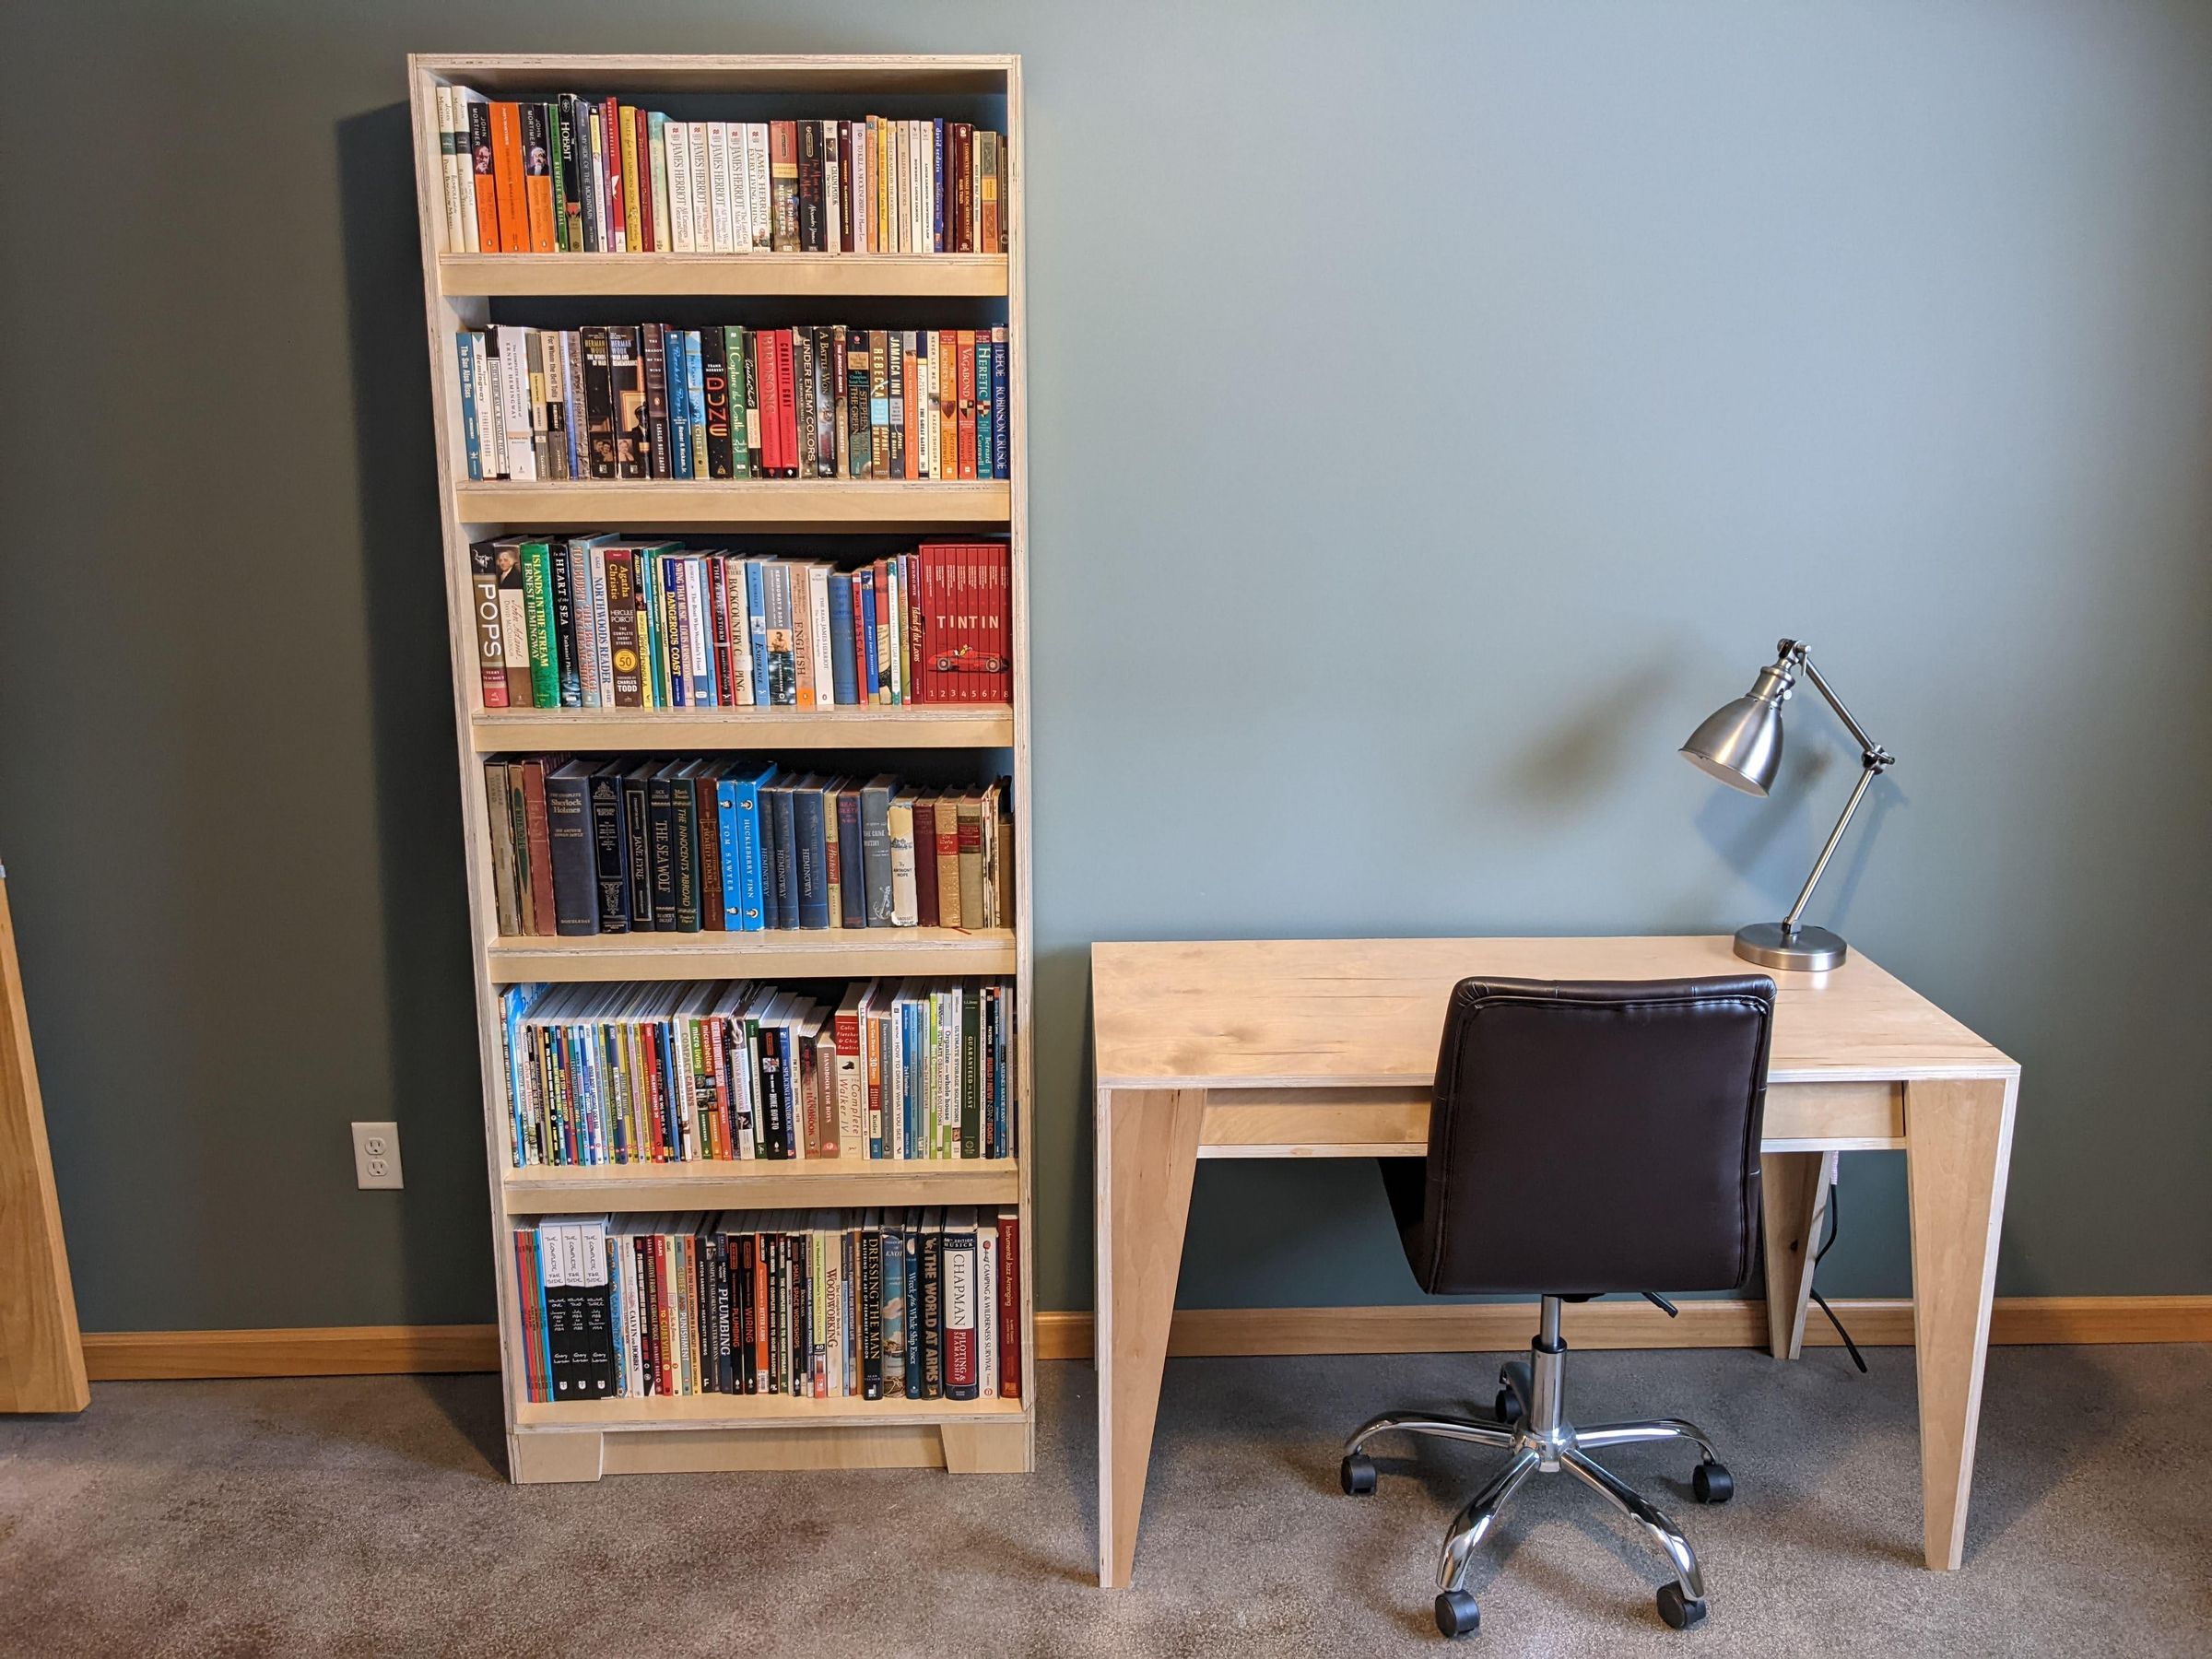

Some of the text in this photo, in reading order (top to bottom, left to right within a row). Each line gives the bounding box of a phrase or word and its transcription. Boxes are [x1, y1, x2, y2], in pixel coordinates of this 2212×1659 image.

[527, 111, 535, 146] MORTIMER
[561, 122, 571, 161] HOBBIT
[582, 135, 587, 144] MY
[671, 143, 687, 206] JAMES HERRIOT
[692, 142, 707, 206] JAMES HERRIOT
[711, 144, 725, 206] JAMES HERRIOT
[730, 146, 745, 209] JAMES HERRIOT
[755, 147, 768, 227] JAMES HERRIOT
[460, 346, 468, 356] The
[728, 352, 741, 388] Capture
[762, 335, 775, 414] BIRDSONG
[780, 343, 791, 407] CHARLOTTE GRAY
[873, 348, 884, 398] REBECCA
[890, 337, 900, 395] JAMAICA INN
[961, 348, 971, 397] VAGABOND
[978, 347, 991, 396] HERETIC
[732, 391, 740, 401] the
[733, 404, 743, 432] Castle
[803, 339, 816, 461] UNDER ENEMY COLORS
[995, 349, 1006, 469] DEFOE ROBINSON CRUSOE
[556, 559, 568, 625] HEART SEA
[608, 563, 618, 599] Christie
[619, 566, 629, 597] Agatha
[477, 583, 501, 657] POPS
[524, 563, 539, 659] ERNEST HEMINGWAY
[532, 555, 548, 666] ISLANDS IN THE STREAM
[594, 577, 610, 684] NORTHWOODS READER
[666, 591, 678, 644] DANGEROUS
[672, 647, 681, 677] COAST
[728, 579, 745, 691] BACKCOUNTRY CPING
[936, 616, 999, 629] TINTIN
[619, 656, 632, 667] 50
[755, 642, 764, 684] ENDURANCE
[794, 621, 806, 676] ENGLISH
[633, 835, 644, 879] JANE EYRE
[655, 820, 670, 893] THE SEA WOLF
[677, 809, 689, 906] THE INNOCENTS ABROAD
[725, 853, 734, 891] SAWYER
[744, 819, 752, 874] HUCKLEBERRY
[761, 848, 770, 897] HEMINGWAY
[802, 848, 811, 897] HEMINGWAY
[777, 850, 786, 899] HEMINGWAY
[681, 1032, 694, 1106] COMPACT CABINS
[694, 1049, 702, 1068] living
[702, 1025, 712, 1072] microshelters
[782, 1066, 793, 1131] SPLICING HANDBOOK
[840, 1078, 849, 1132] Walker IV
[852, 1084, 860, 1134] Complete
[677, 1267, 686, 1294] CUBES
[826, 1268, 838, 1348] WOODWORKING
[868, 1239, 880, 1359] DRESSING THE MAN
[953, 1253, 966, 1326] CHAPMAN
[718, 1288, 730, 1356] PLUMBING
[924, 1255, 938, 1382] THE WORLD AT ARMS
